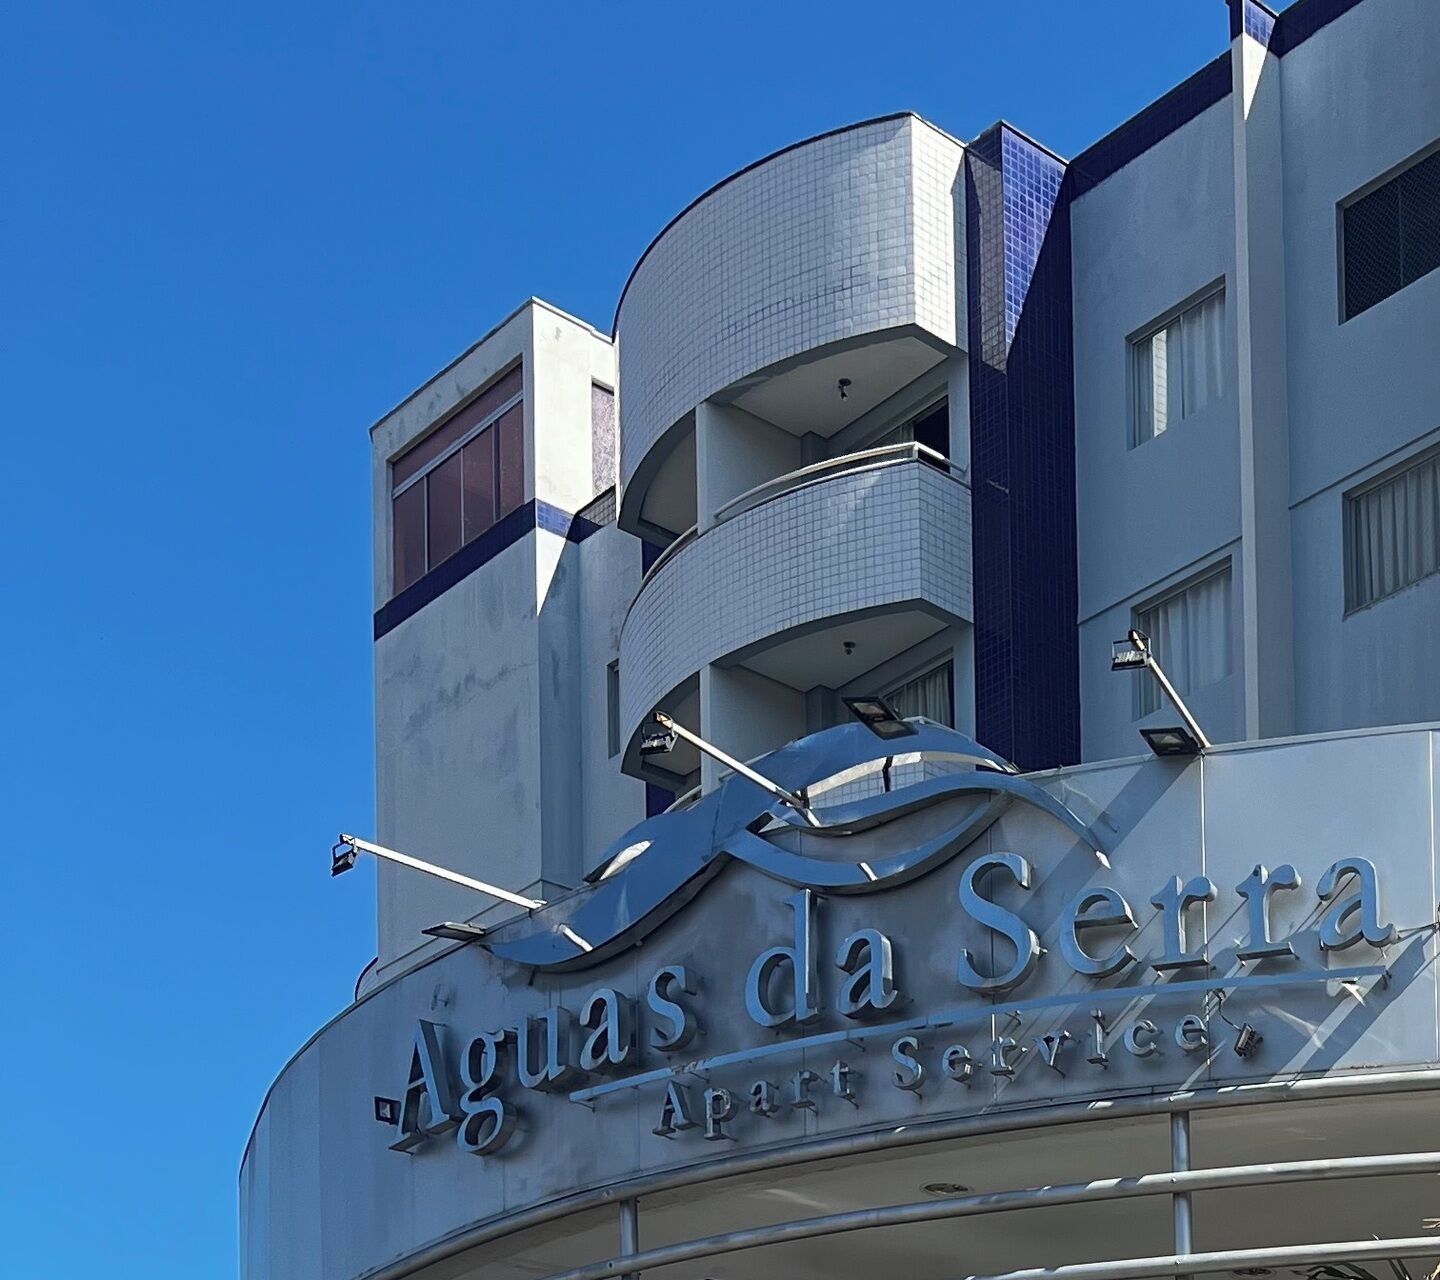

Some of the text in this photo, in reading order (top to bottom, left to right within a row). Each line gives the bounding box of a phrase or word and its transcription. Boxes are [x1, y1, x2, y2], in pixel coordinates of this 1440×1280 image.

[744, 889, 899, 1028] da
[957, 852, 1398, 994] Serra
[653, 1008, 1209, 1140] Apart Service
